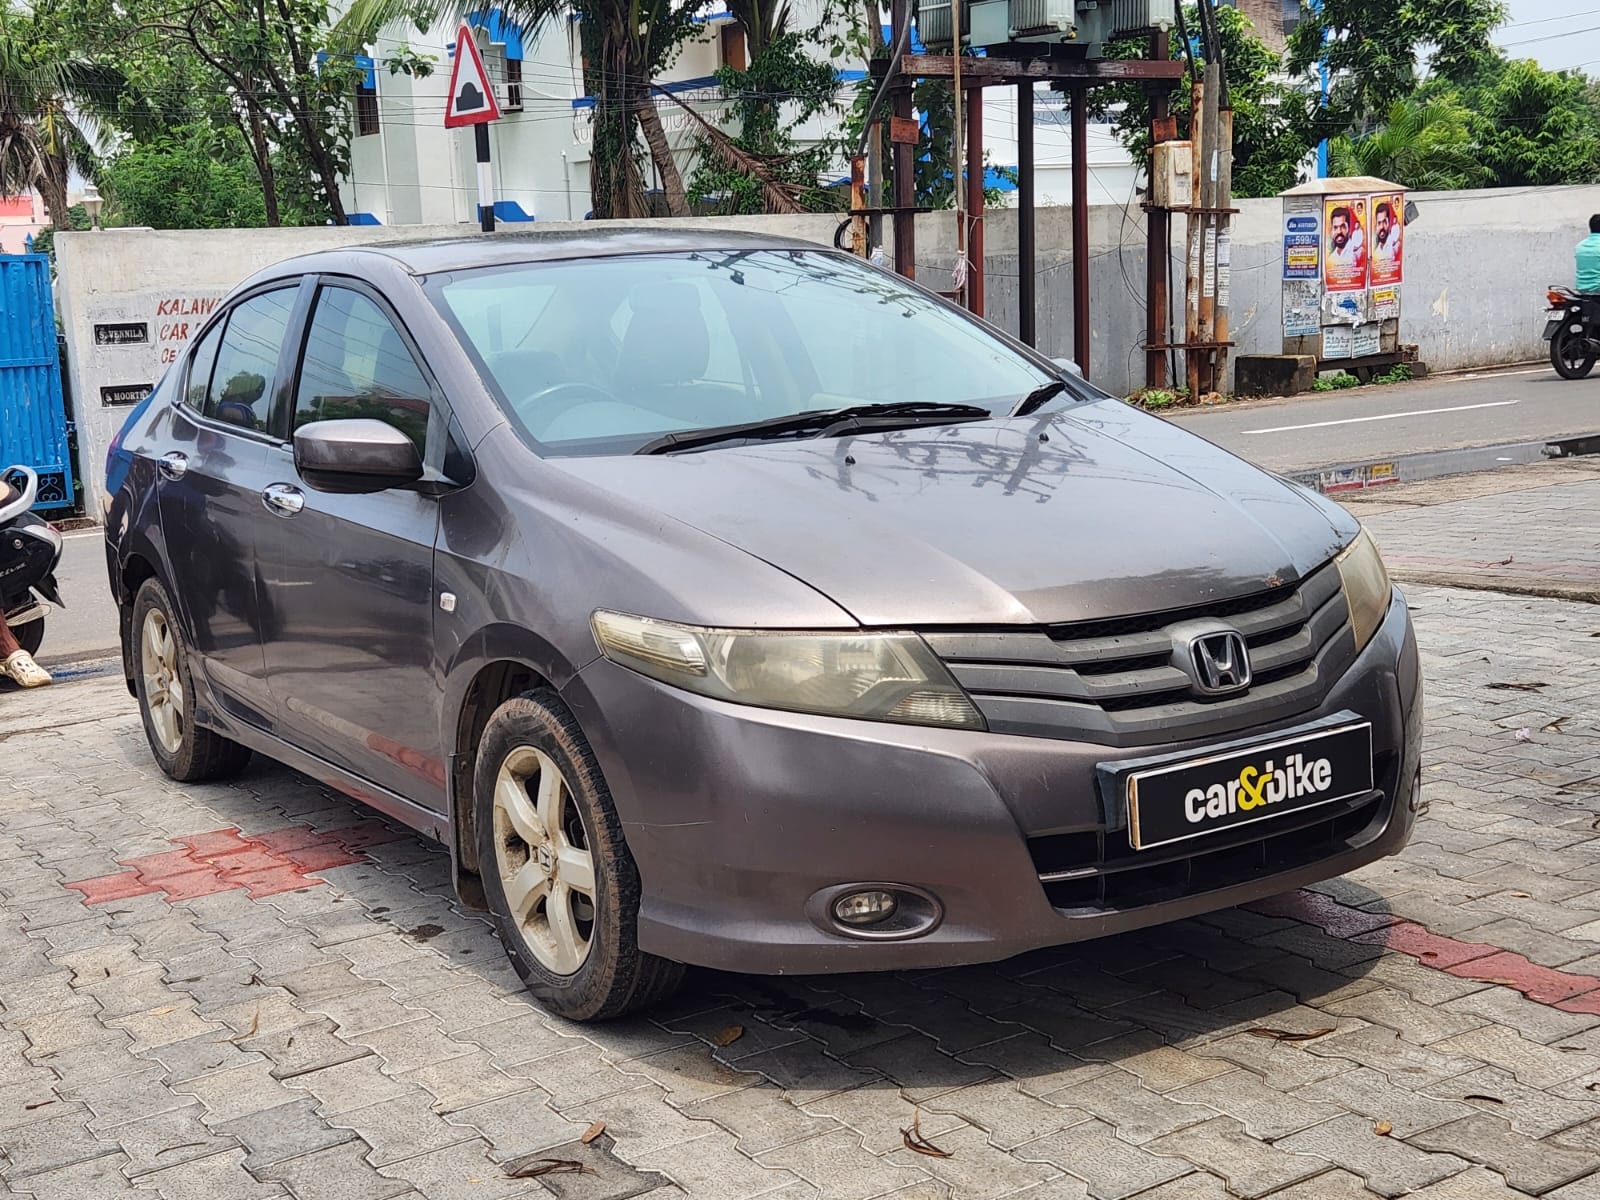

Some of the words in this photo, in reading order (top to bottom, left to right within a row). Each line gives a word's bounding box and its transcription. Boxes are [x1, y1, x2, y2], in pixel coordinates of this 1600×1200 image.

[156, 298, 221, 316] KALAIV
[108, 329, 144, 339] VENNILA
[160, 323, 188, 340] CAR
[161, 348, 181, 364] CE
[1185, 753, 1332, 823] car&bike
